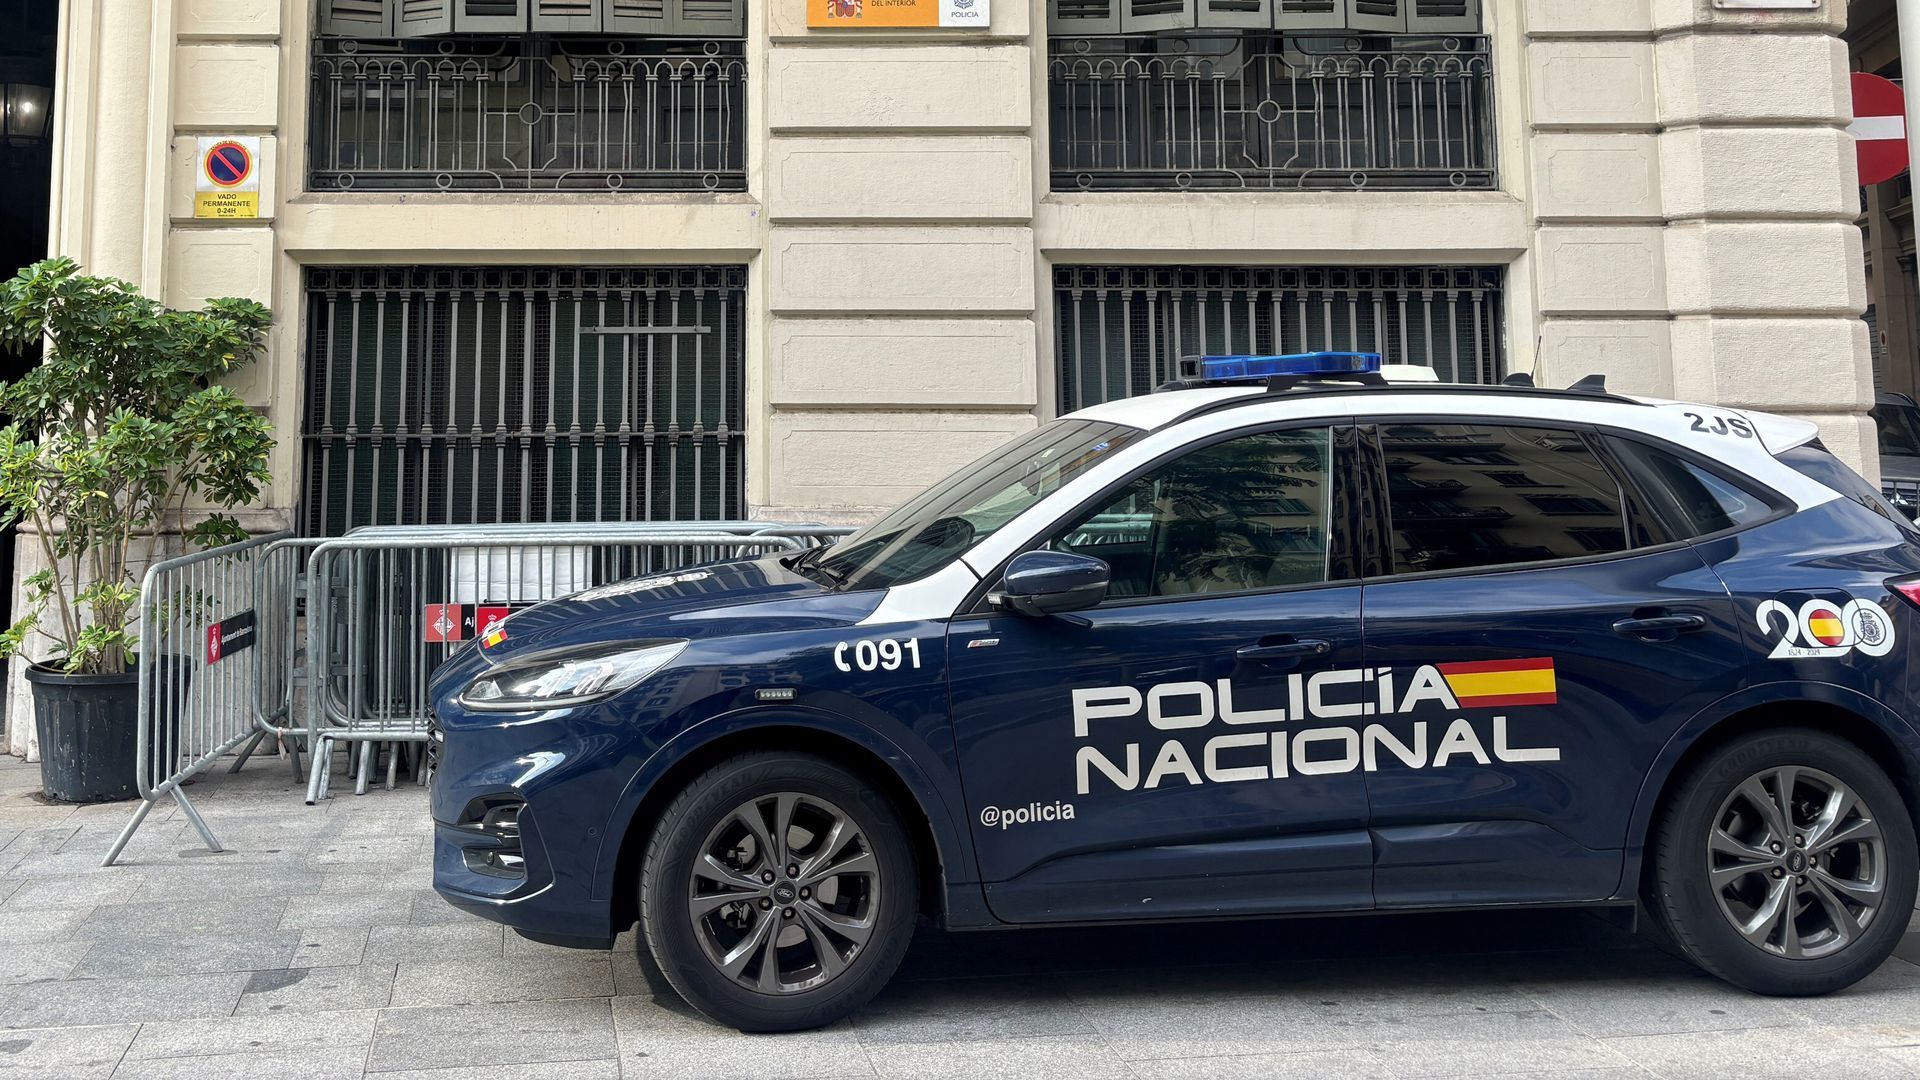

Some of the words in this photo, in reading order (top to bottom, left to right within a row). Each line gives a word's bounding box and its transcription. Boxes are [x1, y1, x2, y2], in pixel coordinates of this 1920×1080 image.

[1683, 412, 1753, 439] 2JS
[855, 637, 921, 672] 091
[1076, 716, 1560, 795] NACIONAL
[980, 800, 1075, 830] @policia
